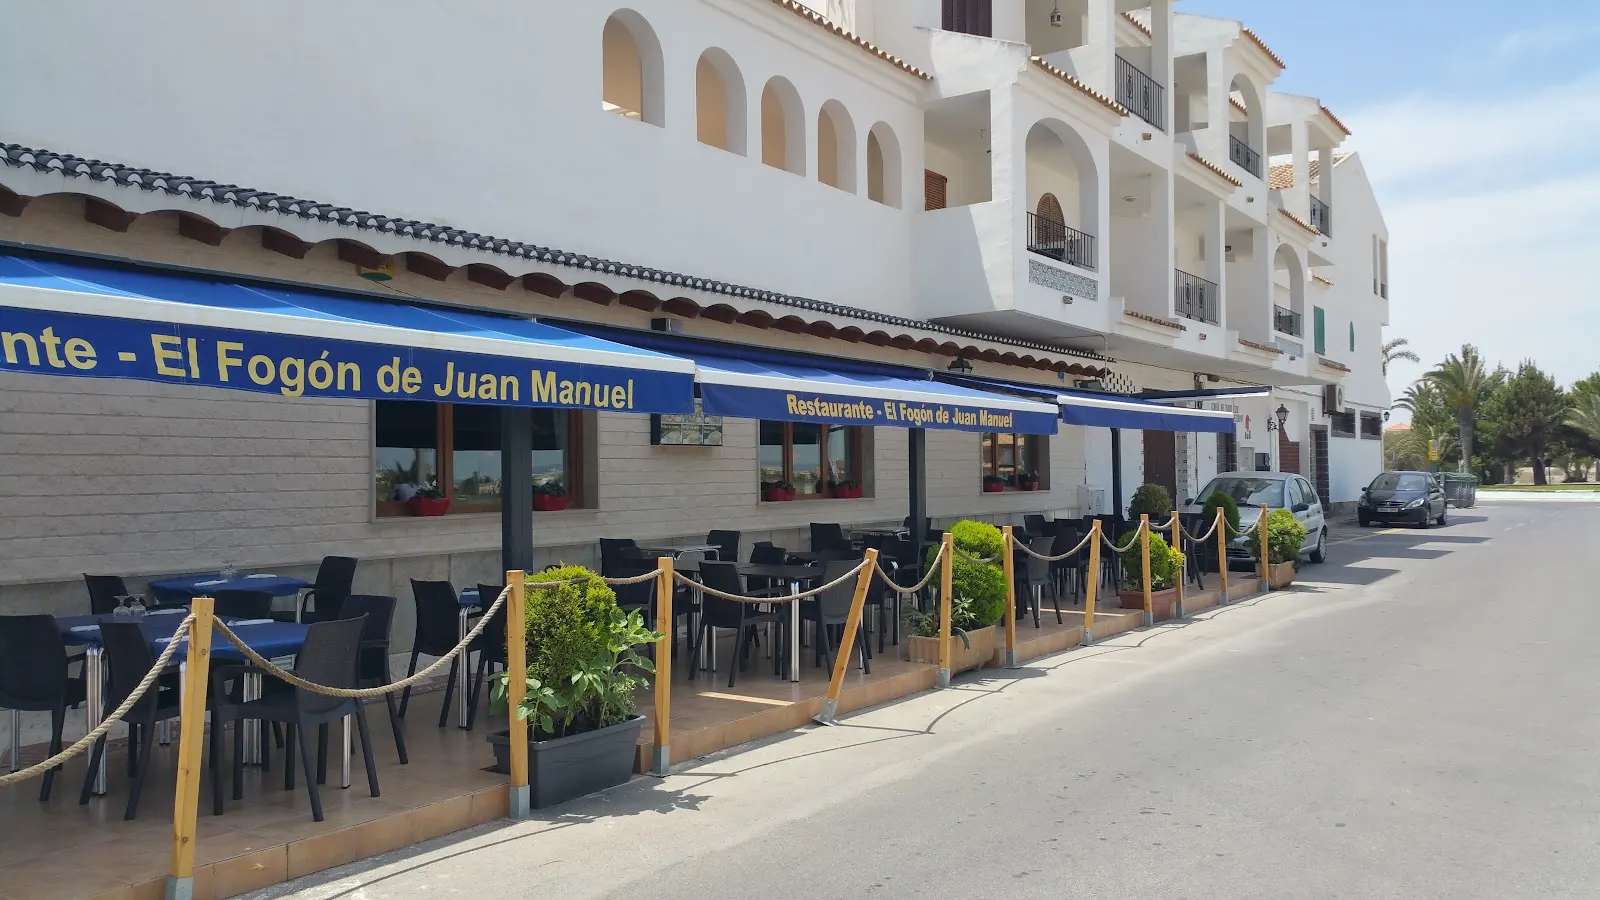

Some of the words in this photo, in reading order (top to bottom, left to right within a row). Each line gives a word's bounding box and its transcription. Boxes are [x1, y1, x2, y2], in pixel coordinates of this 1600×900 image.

[1, 326, 97, 369] nte
[151, 333, 200, 379] El
[216, 340, 361, 397] Fogón
[376, 356, 422, 394] de
[433, 361, 519, 401] Juan
[531, 369, 634, 410] Manuel
[786, 393, 874, 420] Restaurante
[883, 401, 898, 421] El
[899, 402, 934, 426] Fogón
[935, 406, 950, 425] de
[952, 407, 977, 426] Juan
[979, 409, 1013, 428] Manuel
